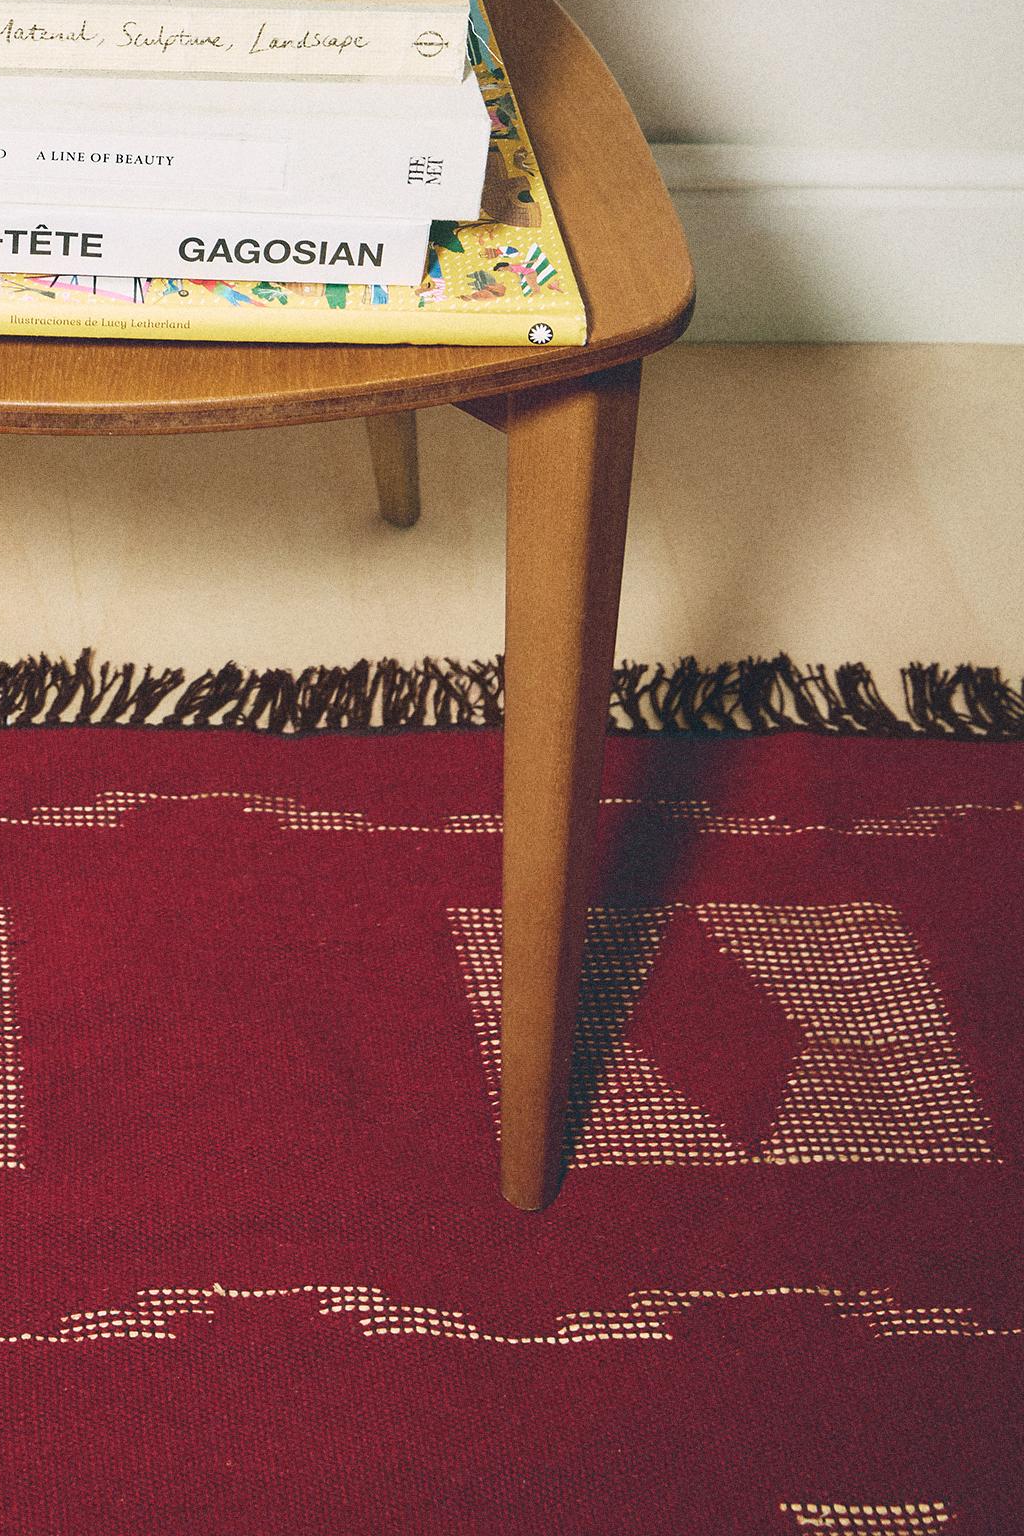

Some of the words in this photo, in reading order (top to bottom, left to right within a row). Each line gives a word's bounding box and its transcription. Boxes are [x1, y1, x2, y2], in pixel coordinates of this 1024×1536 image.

[118, 21, 234, 53] Sculpture,
[249, 23, 371, 55] Landscape
[36, 150, 46, 161] A
[50, 151, 86, 162] LINE
[89, 152, 111, 163] OF
[115, 154, 175, 166] BEAUTY
[407, 156, 426, 185] THE
[425, 156, 444, 185] MET
[178, 236, 385, 268] GAGOSIAN
[10, 314, 82, 327] Ilustraciones
[84, 316, 98, 327] de
[101, 318, 127, 330] Lucy
[130, 319, 191, 330] Letherland
